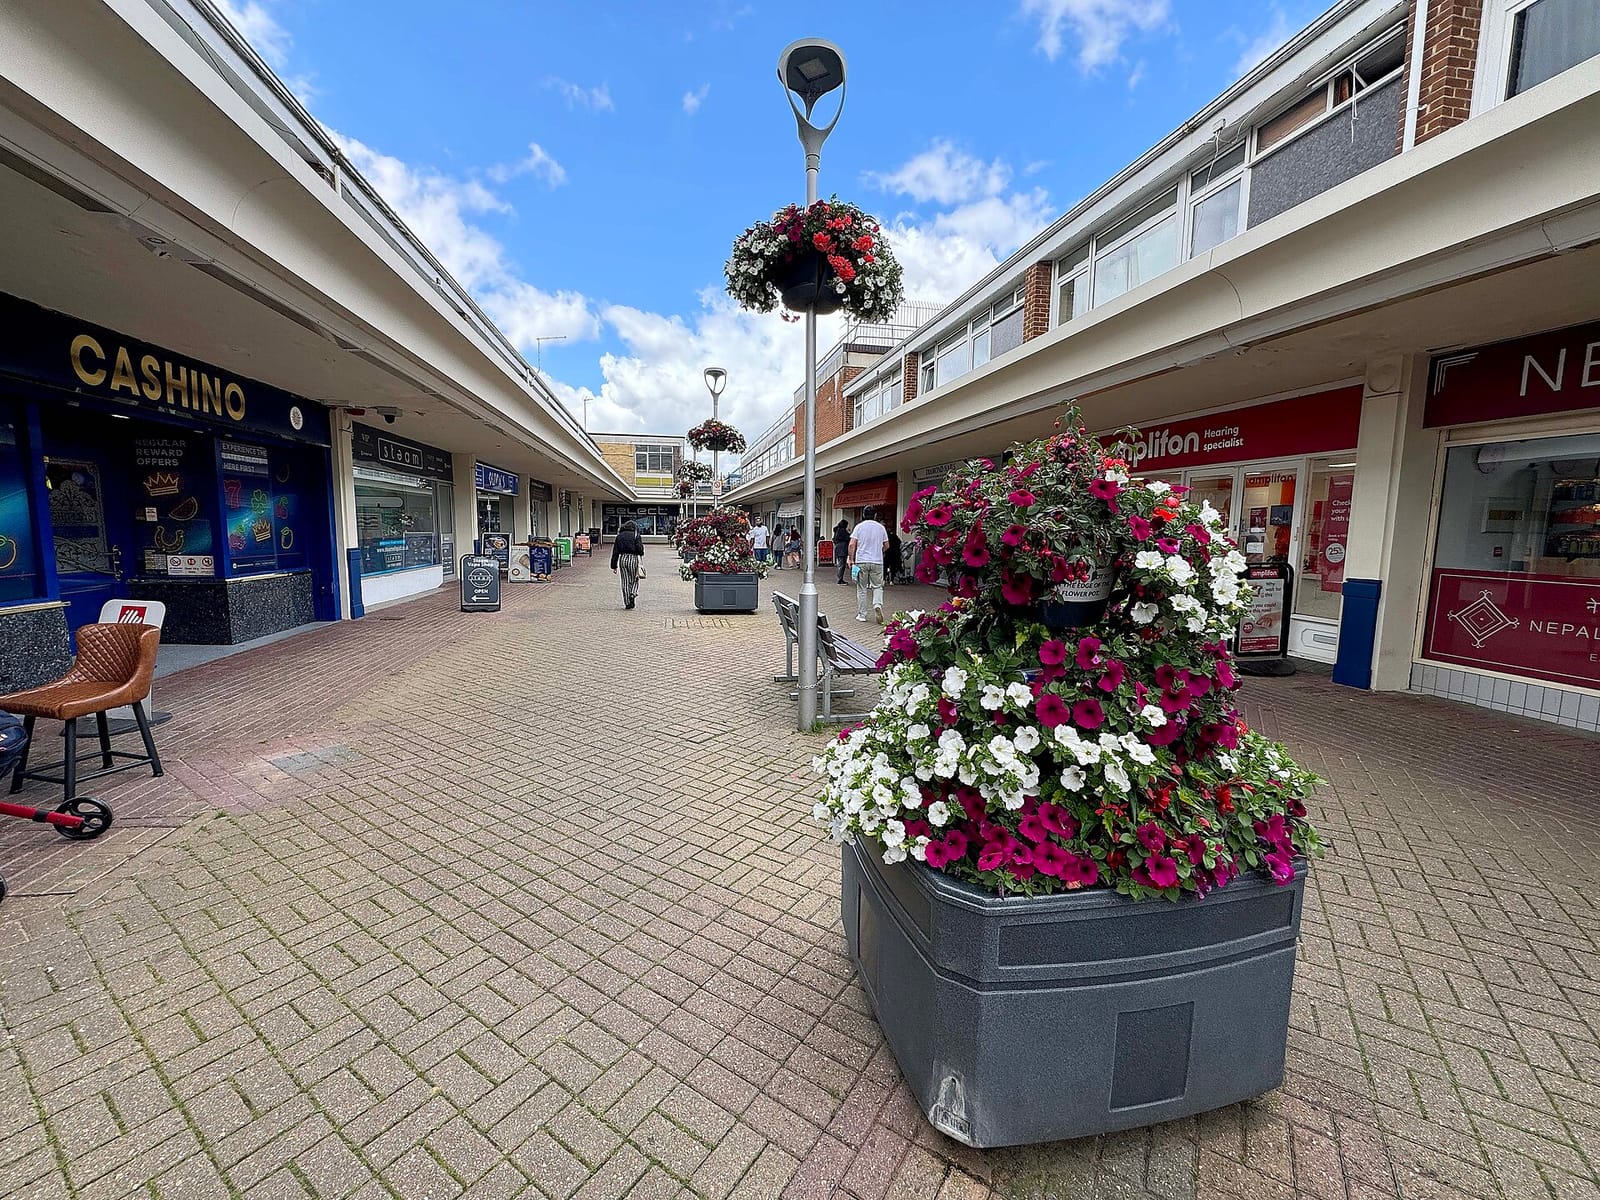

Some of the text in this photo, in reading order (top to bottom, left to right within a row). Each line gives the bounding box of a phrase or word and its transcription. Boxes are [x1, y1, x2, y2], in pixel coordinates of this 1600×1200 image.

[70, 334, 246, 421] CASHINO
[1204, 425, 1240, 440] Hearing
[135, 439, 187, 449] REGULAR
[1203, 438, 1245, 454] specialist
[135, 448, 184, 457] REWARD
[136, 457, 180, 467] OFFERS
[223, 463, 240, 471] HERE
[1250, 473, 1294, 487] amplifon
[1331, 508, 1346, 516] your
[1252, 569, 1278, 579] amplifon
[1077, 581, 1093, 589] EDGE
